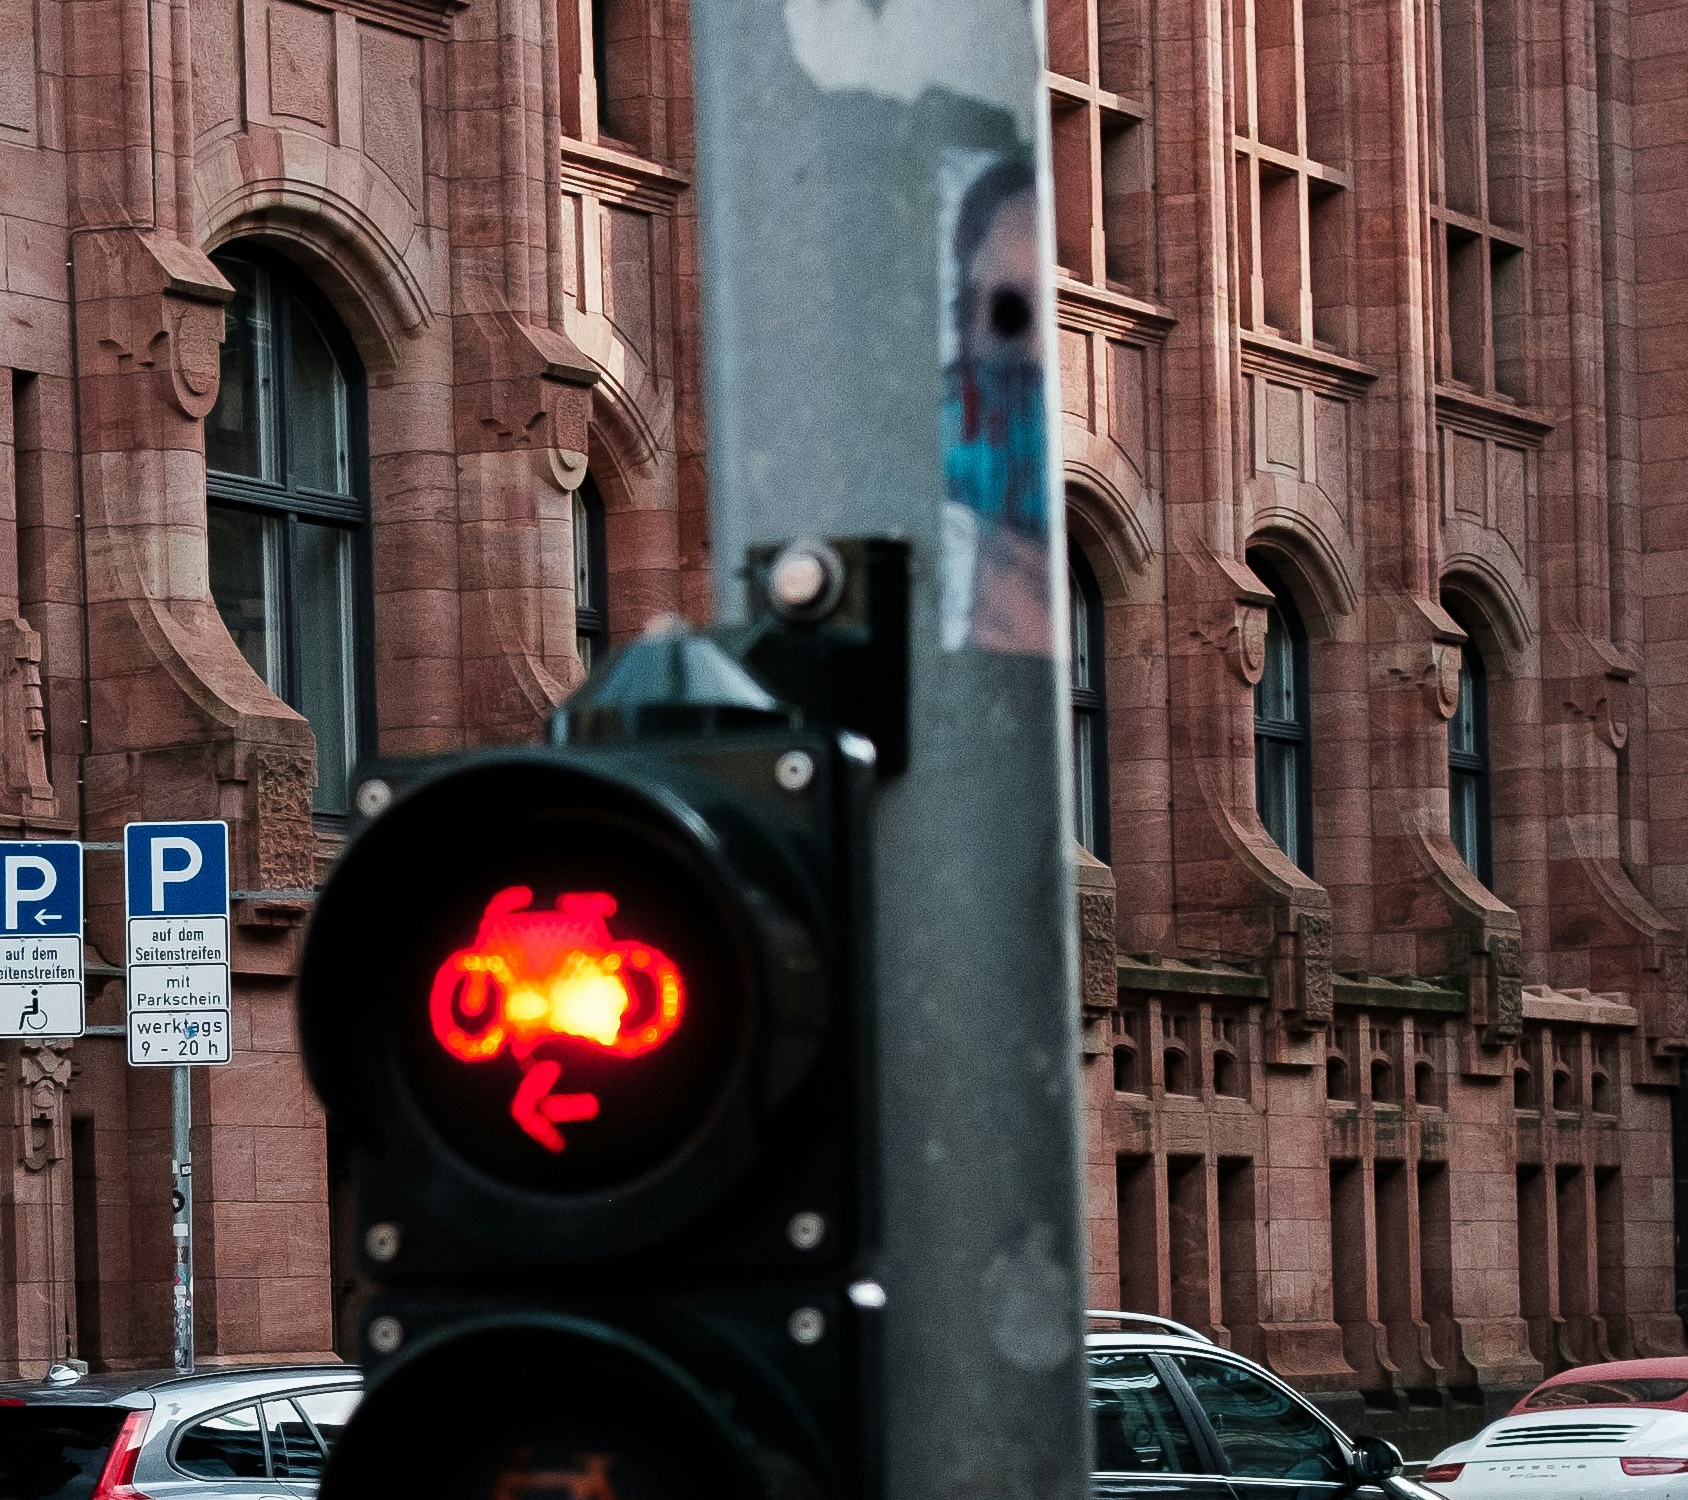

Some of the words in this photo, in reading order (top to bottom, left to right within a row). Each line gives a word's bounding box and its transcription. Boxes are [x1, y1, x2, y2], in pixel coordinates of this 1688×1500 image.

[150, 837, 203, 912] P
[5, 856, 58, 930] P
[152, 927, 172, 942] auf
[178, 926, 204, 942] dem
[5, 946, 25, 961] auf
[32, 946, 58, 961] dem
[135, 945, 221, 961] Seitenstreifen
[166, 974, 190, 989] mit
[137, 992, 221, 1006] Parkschein
[137, 1017, 223, 1037] werktags
[141, 1040, 151, 1057] 9
[178, 1040, 199, 1056] 20
[208, 1039, 219, 1056] h
